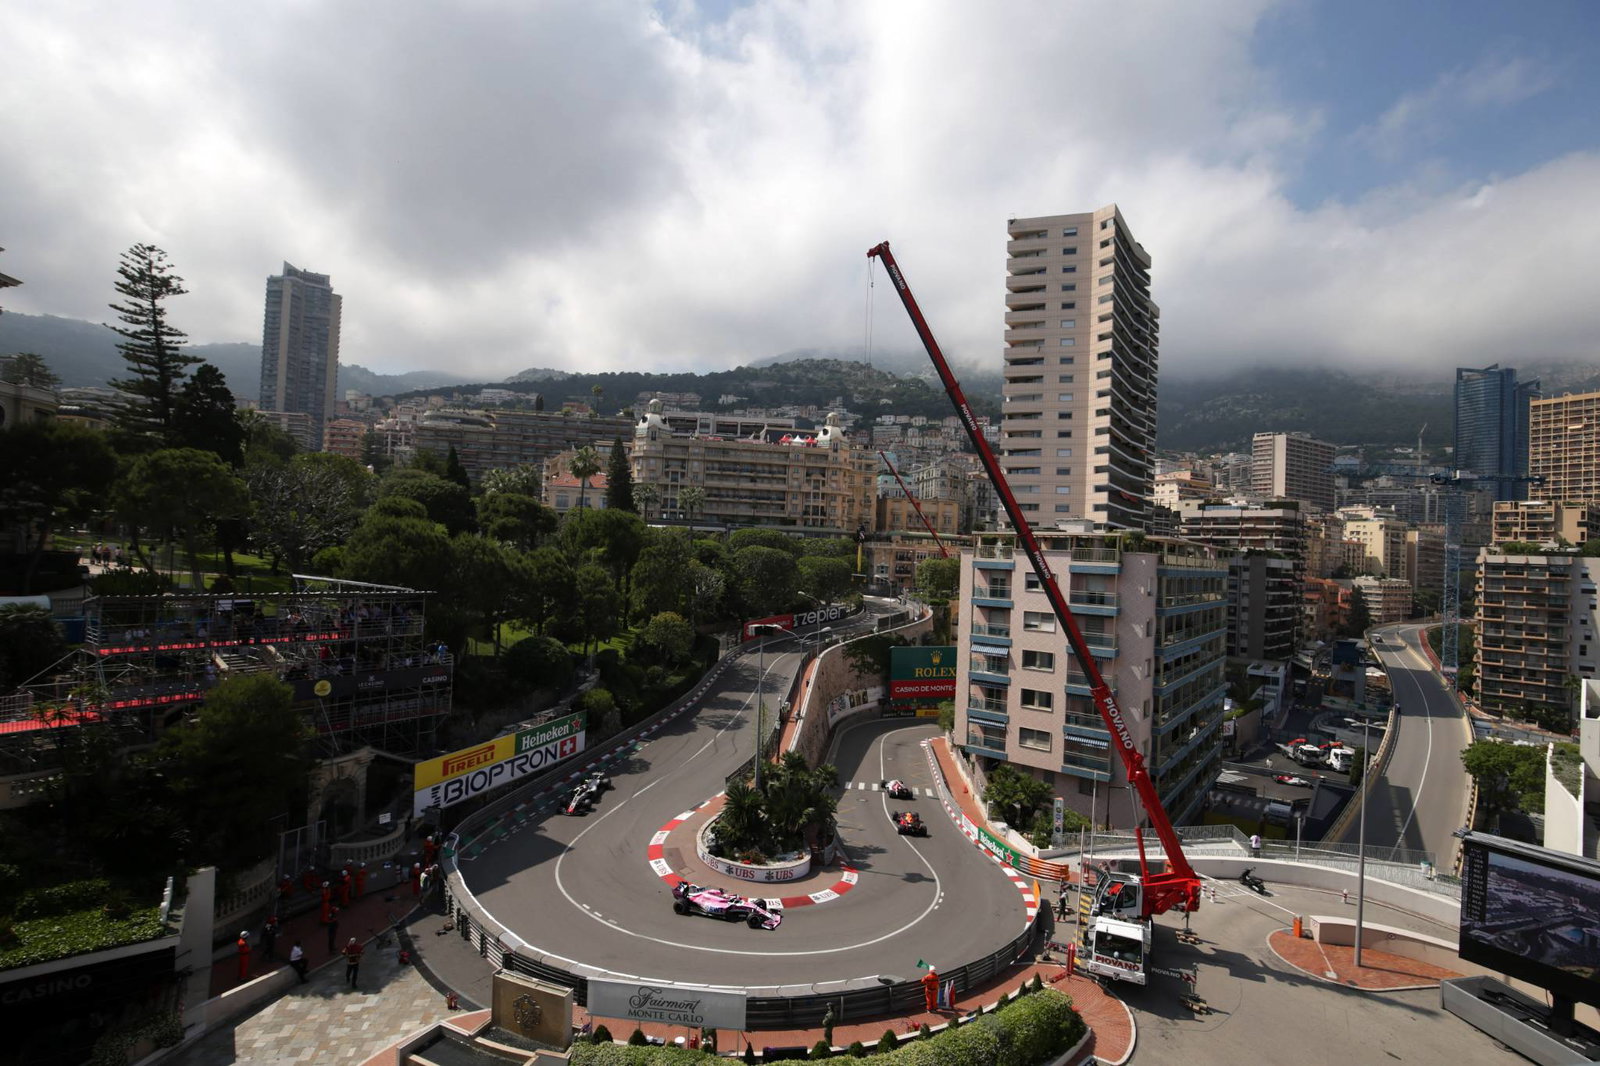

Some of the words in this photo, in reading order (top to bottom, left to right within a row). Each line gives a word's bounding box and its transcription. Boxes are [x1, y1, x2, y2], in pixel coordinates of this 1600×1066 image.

[960, 403, 977, 431] PIOVANO
[1034, 551, 1050, 579] PIOVANO
[801, 607, 843, 626] zepter
[915, 667, 956, 678] ROLEX
[522, 722, 569, 750] Heineken
[1104, 697, 1133, 749] PIOVANO
[442, 744, 495, 777] PIRELLI
[444, 743, 558, 804] BIOPTRON
[706, 856, 719, 869] UBS
[735, 867, 755, 879] UBS
[775, 869, 794, 880] UBS
[1095, 955, 1140, 971] PIOVANO
[1, 974, 93, 1004] CASINO
[629, 986, 700, 1013] Fairmont
[628, 1009, 665, 1022] MONTE
[668, 1011, 704, 1024] CARLO
